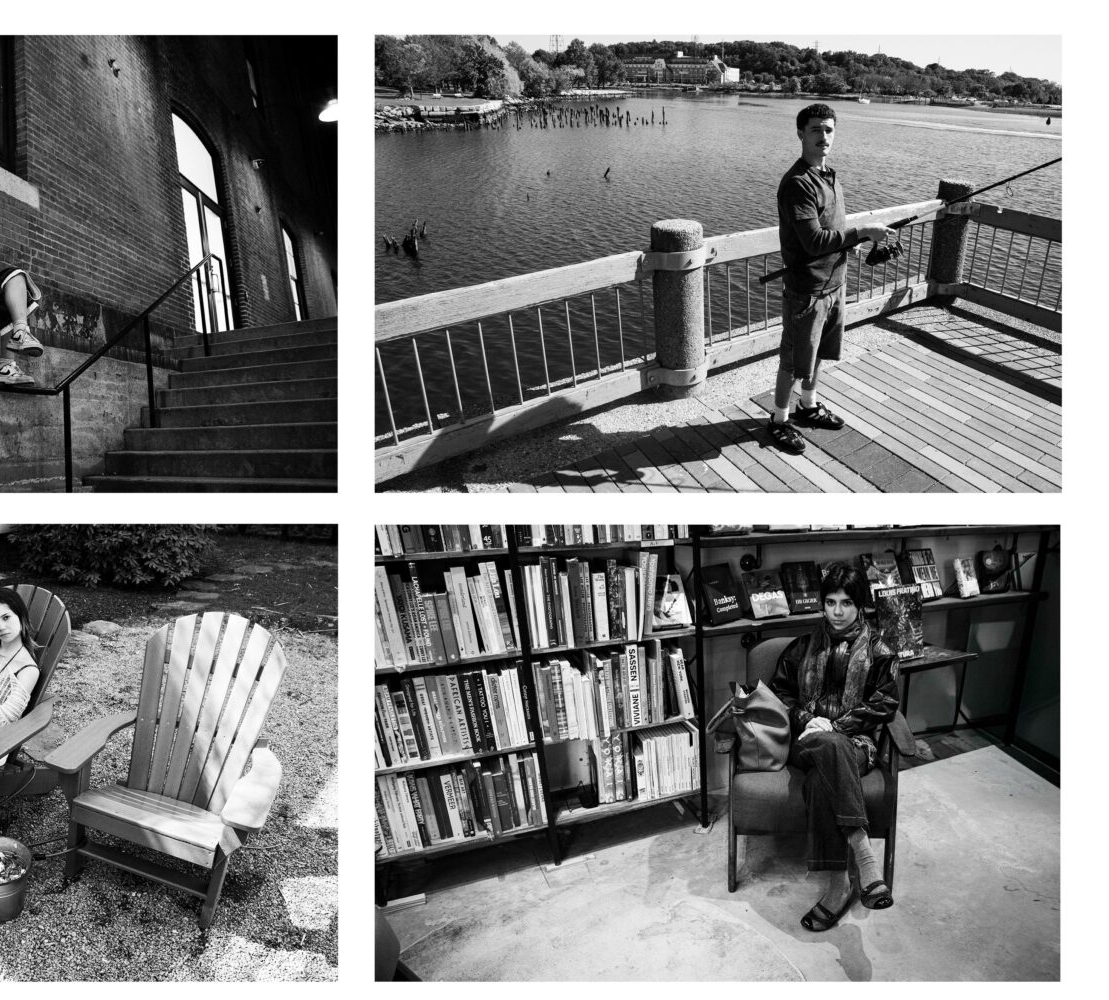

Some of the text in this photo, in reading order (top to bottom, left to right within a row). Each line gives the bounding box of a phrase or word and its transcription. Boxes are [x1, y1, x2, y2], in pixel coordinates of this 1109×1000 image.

[411, 575, 424, 610] LACHAPELLE
[418, 610, 426, 624] LOST
[713, 594, 737, 606] Banksy:
[751, 590, 784, 602] DEGAS
[878, 588, 896, 598] LOUIS
[895, 585, 920, 596] FRATINO
[400, 614, 412, 643] KUSAMA
[628, 648, 637, 681] SASSEN
[898, 650, 915, 658] TURA
[476, 687, 487, 707] TATTOO
[449, 682, 463, 715] AFRICAN
[457, 717, 469, 743] ARTISTS
[631, 694, 640, 725] VIVIANE
[411, 791, 420, 809] WHAT
[442, 780, 456, 810] VERMEER
